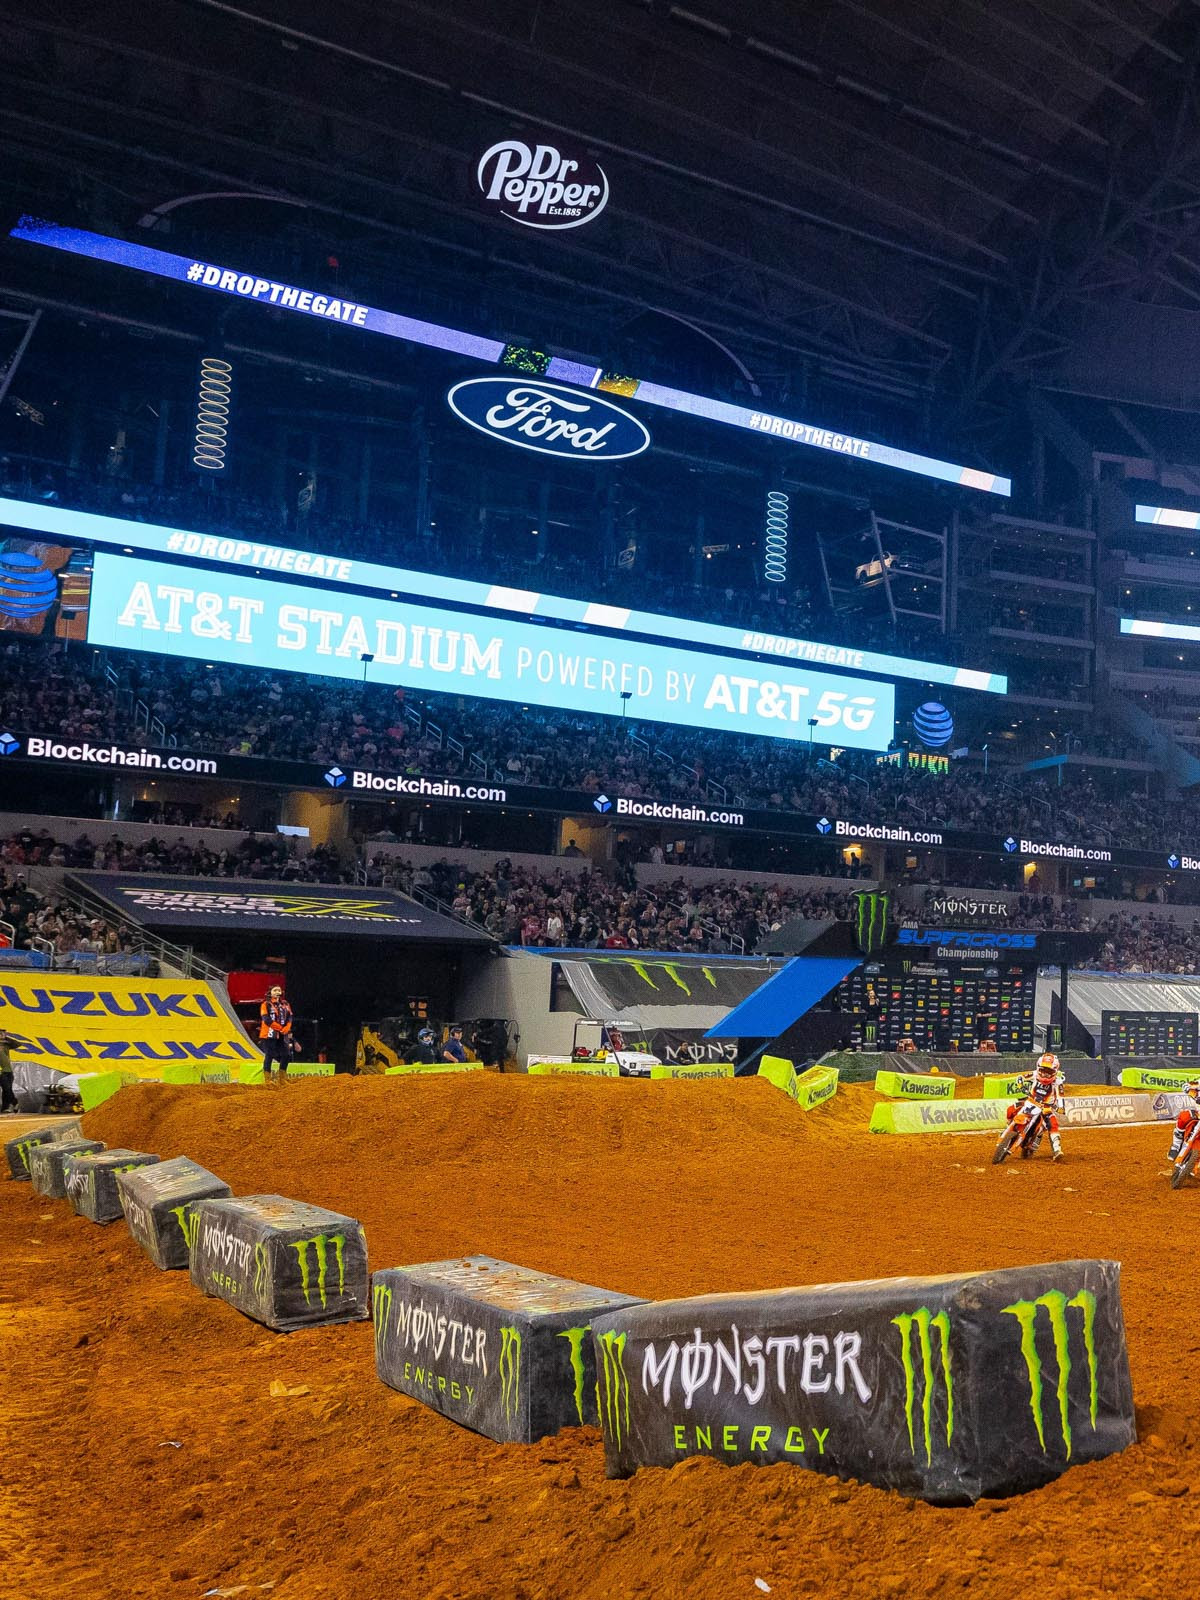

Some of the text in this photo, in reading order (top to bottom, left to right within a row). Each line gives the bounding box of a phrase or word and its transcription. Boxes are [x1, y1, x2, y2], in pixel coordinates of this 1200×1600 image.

[479, 140, 601, 214] Pepper
[527, 144, 579, 182] Dr
[187, 262, 369, 326] #DROPTHEGATE
[486, 387, 616, 452] Ford
[749, 412, 870, 458] #DROPTHEGATE
[167, 531, 353, 580] #DROPTHEGATE
[117, 580, 877, 732] AT&T STADIUM POWERED BY AT&T 5G
[741, 633, 865, 667] #DROPTHEGATE
[27, 738, 217, 774] Blockchain.com
[352, 771, 507, 802] Blockchain.com
[616, 799, 744, 826] Blockchain.com
[835, 820, 943, 845] Blockchain.com
[1020, 840, 1112, 862] Blockchain.com
[146, 906, 422, 923] WORLD CHAMPIONSHIP
[933, 900, 1008, 916] MONSTER
[897, 929, 1037, 948] SUPERCROSS
[902, 921, 919, 929] AMA
[937, 947, 999, 960] Championship
[900, 1080, 950, 1096] Kawasaki
[1074, 1097, 1132, 1107] ROCKY MOUNTAIN
[920, 1103, 999, 1125] Kawasaki
[202, 1223, 251, 1277] MONSTER
[207, 1270, 243, 1294] NERGY
[396, 1299, 488, 1378] MONSTER
[642, 1324, 872, 1410] MONSTER
[404, 1362, 475, 1404] ENERGY
[674, 1425, 830, 1455] ENERGY
